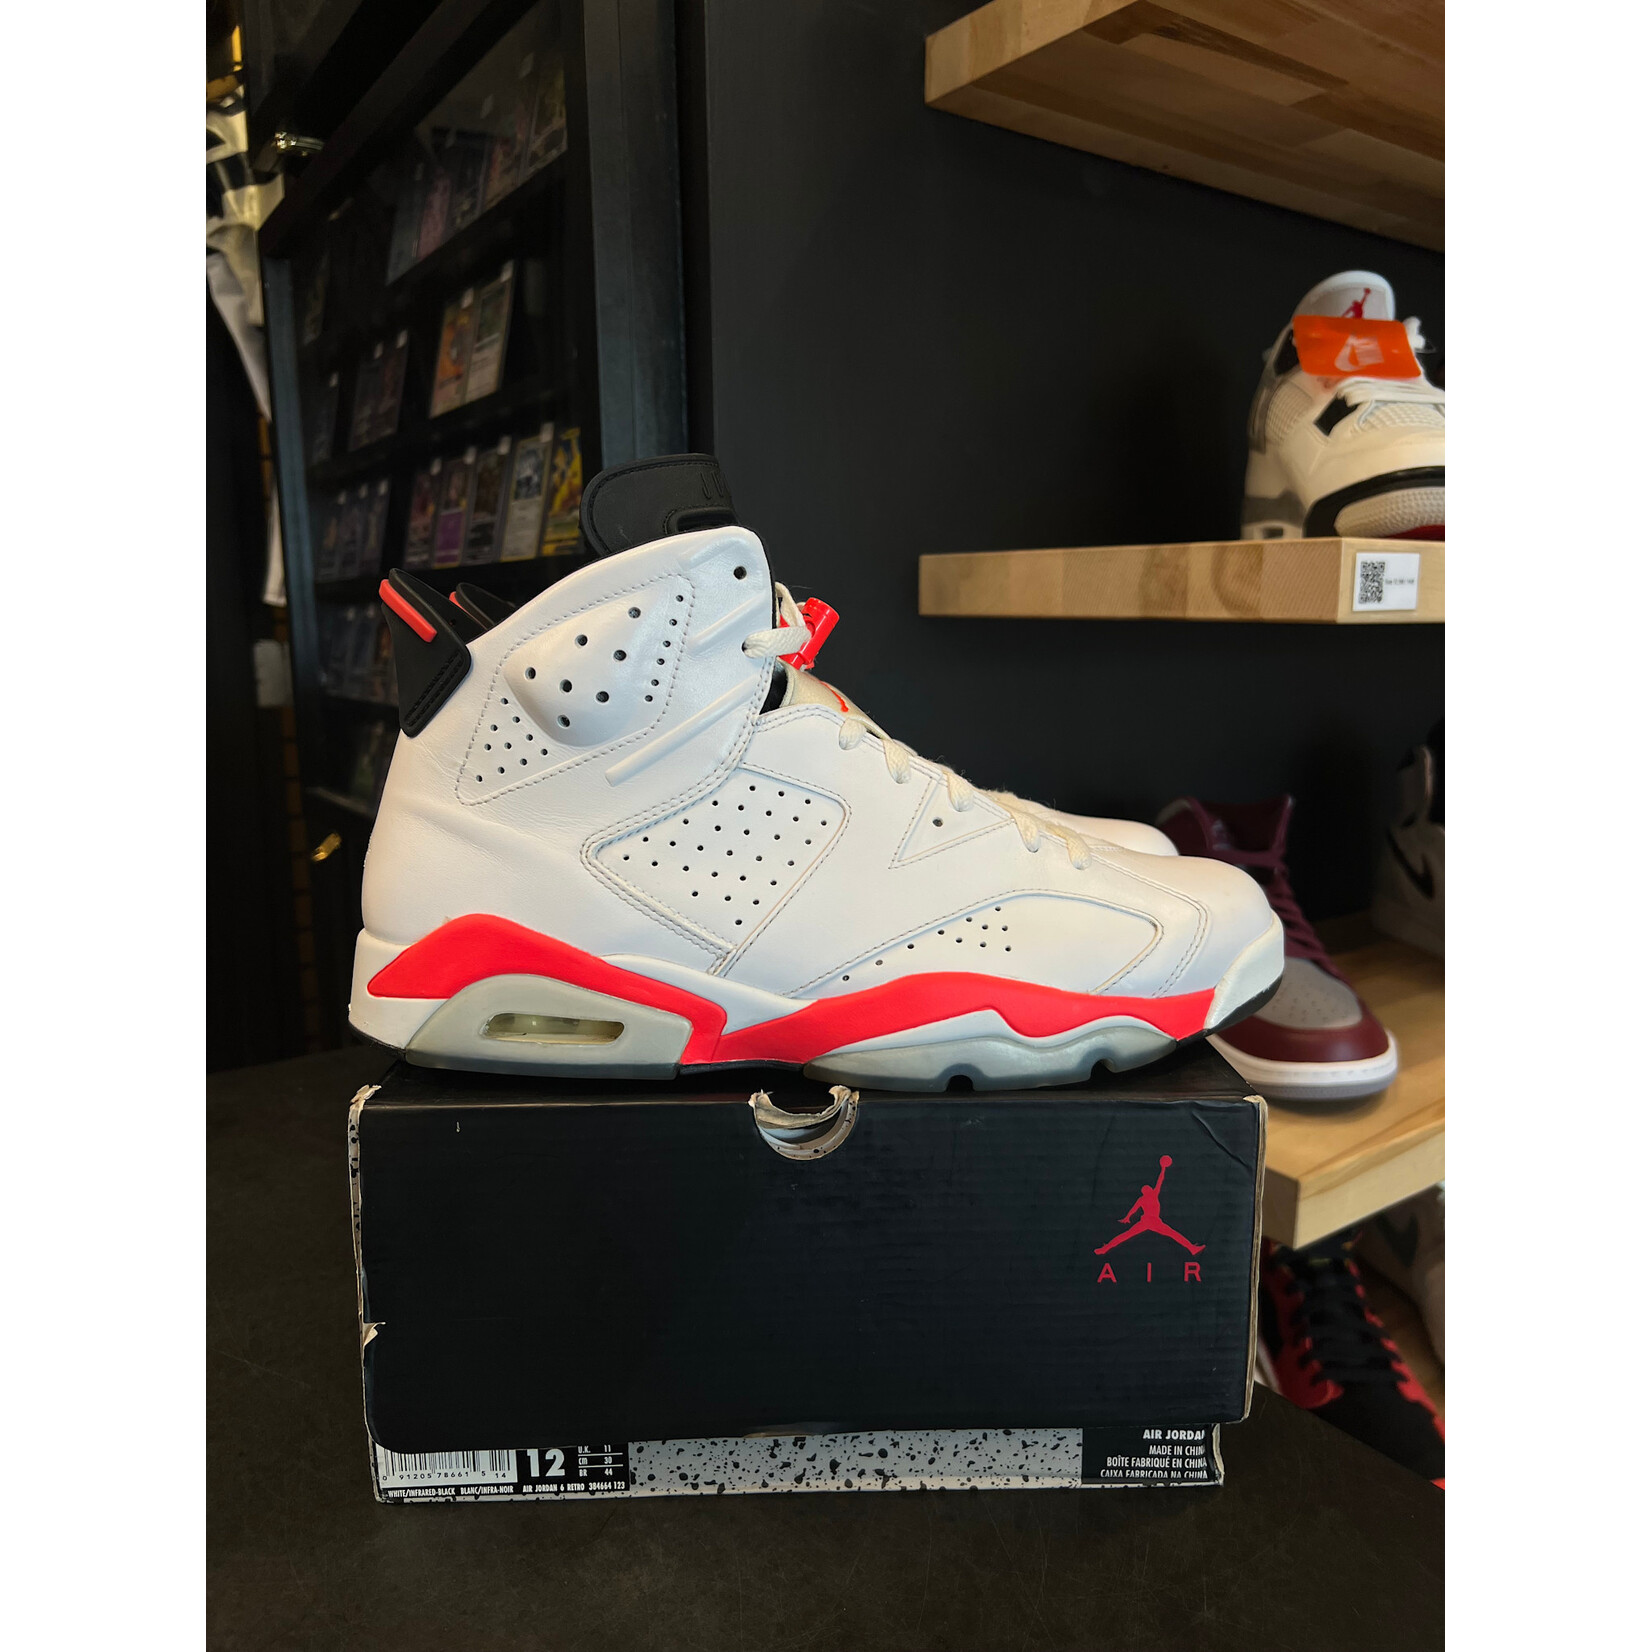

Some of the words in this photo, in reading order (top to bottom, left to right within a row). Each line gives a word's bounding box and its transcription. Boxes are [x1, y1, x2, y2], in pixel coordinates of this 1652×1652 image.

[1097, 1262, 1201, 1283] AIR
[1143, 1429, 1163, 1440] AIR
[604, 1444, 611, 1453] 11
[1149, 1445, 1172, 1456] MADE
[1174, 1445, 1183, 1456] IN
[527, 1448, 566, 1478] 12
[604, 1456, 612, 1464] 30
[1106, 1455, 1129, 1467] BOÎTE
[1131, 1456, 1170, 1468] FABRIQUÉ
[1172, 1458, 1182, 1468] EN
[1184, 1457, 1208, 1468] CHINA
[604, 1468, 613, 1476] 44
[1100, 1469, 1123, 1478] CAIXA
[1125, 1470, 1168, 1479] FABRICADA
[1170, 1470, 1182, 1479] NA
[1184, 1470, 1208, 1479] CHINA
[388, 1487, 456, 1498] WHITE/INFRARED-BLACK
[460, 1485, 514, 1496] BLANC/INFRA-NOIR
[522, 1484, 533, 1492] AIR
[535, 1483, 558, 1492] JORDAN
[560, 1483, 565, 1491] 6
[567, 1482, 585, 1491] RETRO
[588, 1481, 612, 1490] 384664
[613, 1481, 625, 1490] 123
